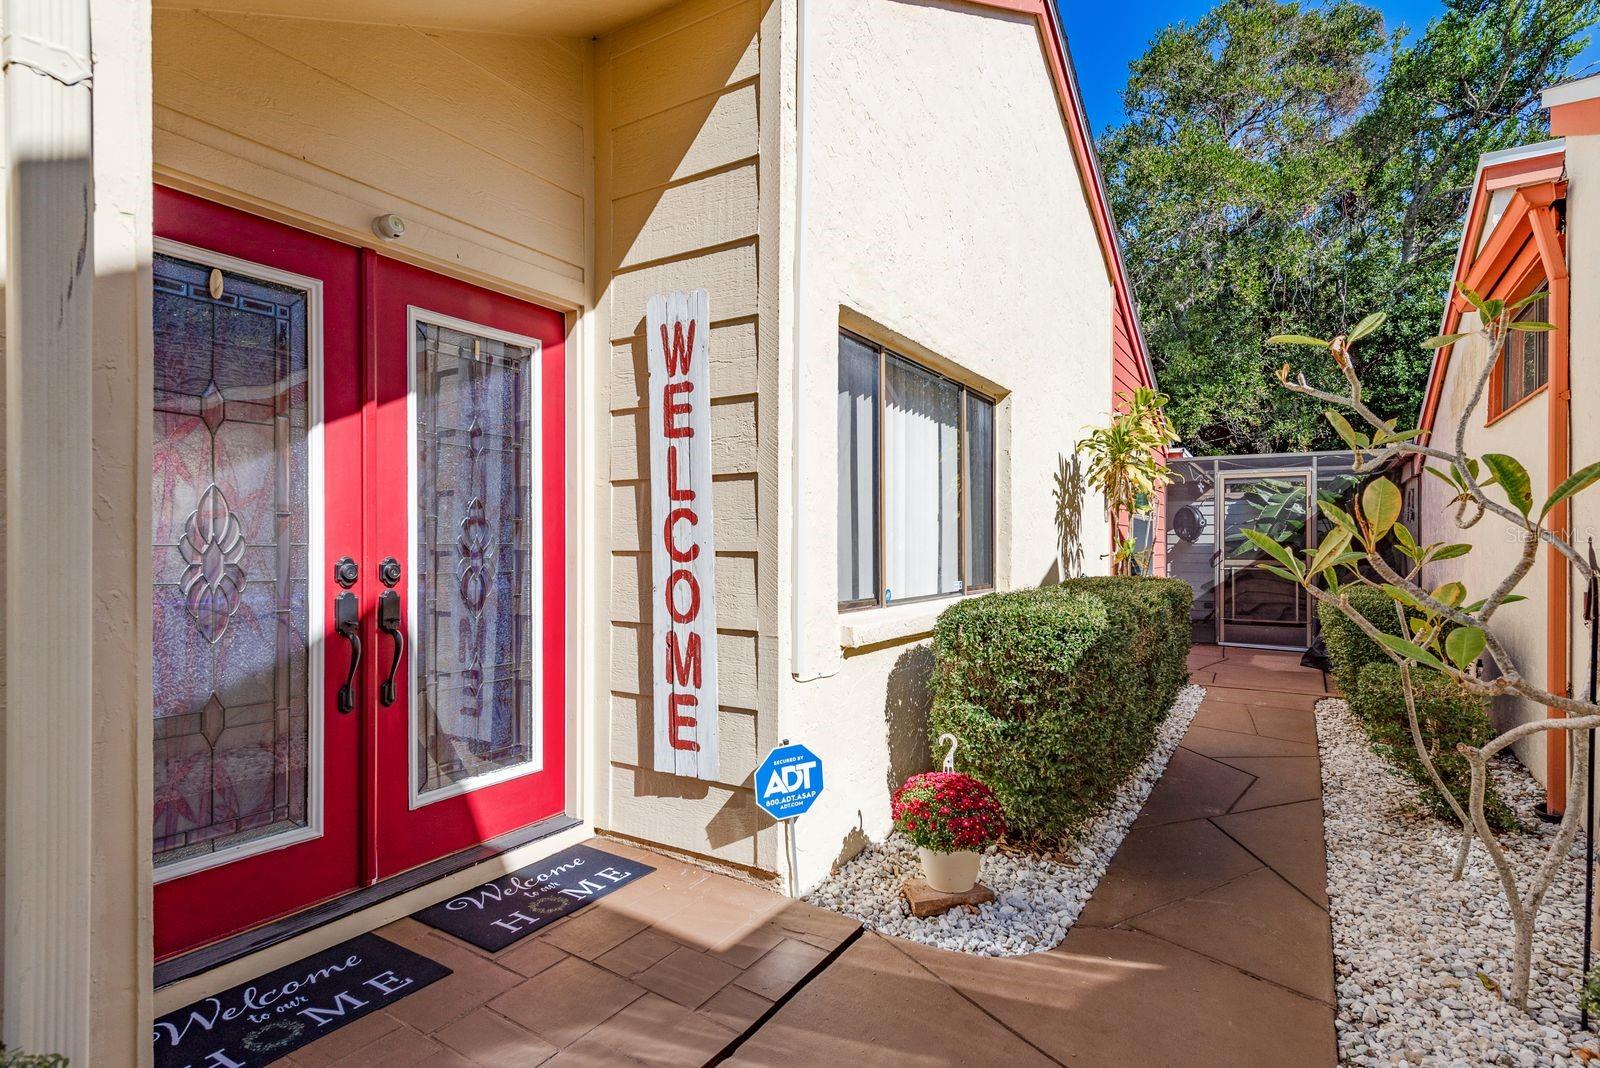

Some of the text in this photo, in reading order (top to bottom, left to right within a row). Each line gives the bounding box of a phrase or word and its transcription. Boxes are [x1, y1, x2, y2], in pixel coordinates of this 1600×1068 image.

[660, 318, 702, 752] WELCOME
[773, 757, 796, 766] SECURED
[764, 761, 816, 798] ADT
[780, 801, 803, 810] ADT.COM
[445, 857, 586, 912] Welcome
[523, 881, 561, 898] to our
[153, 955, 362, 1046] Welcome
[247, 995, 309, 1024] to our
